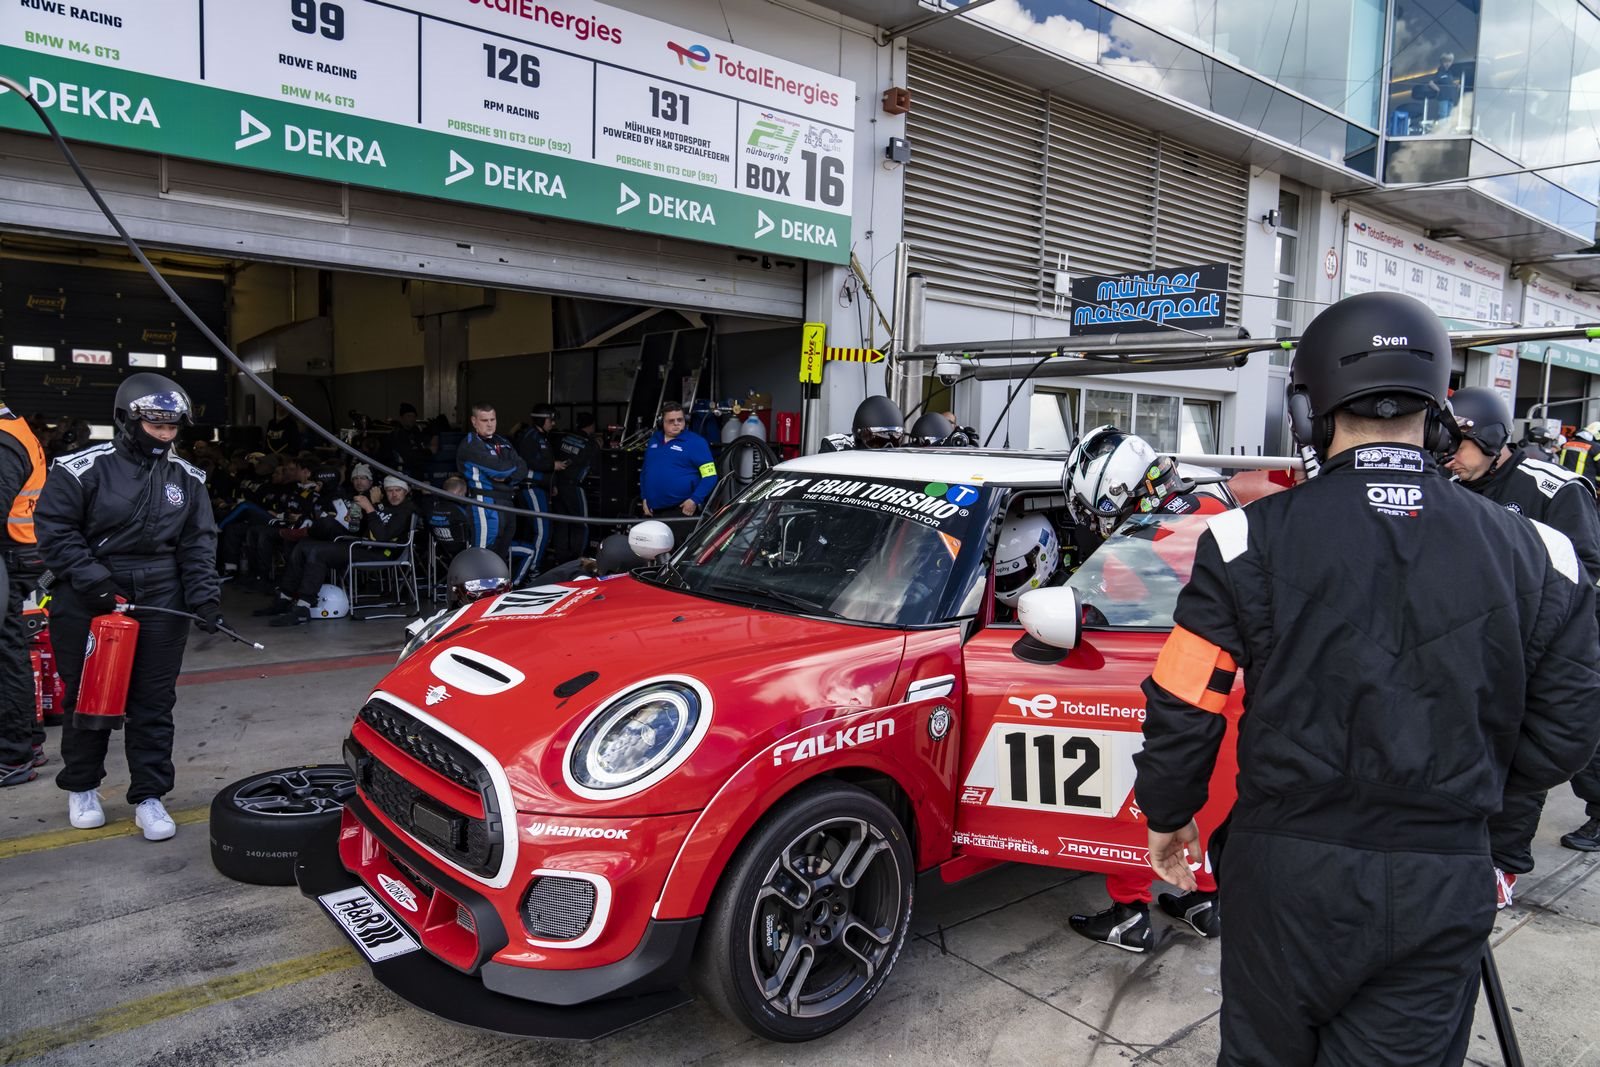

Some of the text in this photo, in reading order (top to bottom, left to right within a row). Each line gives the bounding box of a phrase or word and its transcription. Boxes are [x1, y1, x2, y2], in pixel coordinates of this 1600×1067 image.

[20, 0, 122, 28] ROWE RACING
[291, 0, 345, 41] 99
[467, 0, 622, 44] alEnergies
[25, 30, 120, 61] BMW M4 GT3
[278, 53, 358, 80] ROWE RACING
[483, 43, 541, 88] 126
[715, 53, 839, 107] TotalEnergies
[29, 76, 161, 129] DEKRA
[281, 84, 355, 109] BMW M4 GT3
[483, 99, 540, 120] RPM RACING
[649, 86, 690, 126] 131
[284, 124, 387, 168] DEKRA
[447, 119, 572, 154] PORSCHE 911 GT3 CUP (992)
[602, 126, 730, 163] POWERED BY H&R SPEZIALFEDERN
[625, 120, 712, 149] MÜHLNER MOTORSPORT
[616, 154, 652, 170] PORSCHE
[653, 161, 665, 172] 911
[666, 165, 680, 176] GT3
[681, 168, 697, 179] CUP
[745, 147, 789, 164] nürburgring
[484, 162, 567, 199] DEKRA
[746, 149, 845, 207] BOX 16
[649, 193, 716, 226] DEKRA
[781, 219, 838, 248] DEKRA
[1367, 226, 1404, 249] TotalEnergies
[1356, 249, 1368, 268] 115
[1384, 258, 1397, 276] 143
[1096, 271, 1200, 301] mühlner
[1074, 293, 1220, 326] motorsport
[807, 340, 815, 370] ROWE
[1372, 335, 1408, 347] Sven
[72, 457, 89, 469] OMP
[807, 478, 960, 519] GRAN TURISMO
[955, 485, 976, 502] T
[1367, 487, 1423, 505] OMP
[1541, 480, 1557, 491] OMP
[801, 493, 941, 528] THE REAL DRIVING SIMULATOR
[1060, 701, 1146, 722] TotalEnerg
[773, 718, 895, 767] FALKEN
[1004, 732, 1102, 809] 112
[1068, 843, 1142, 861] RAVENOL
[385, 881, 411, 903] WORKS
[335, 896, 387, 931] H&R
